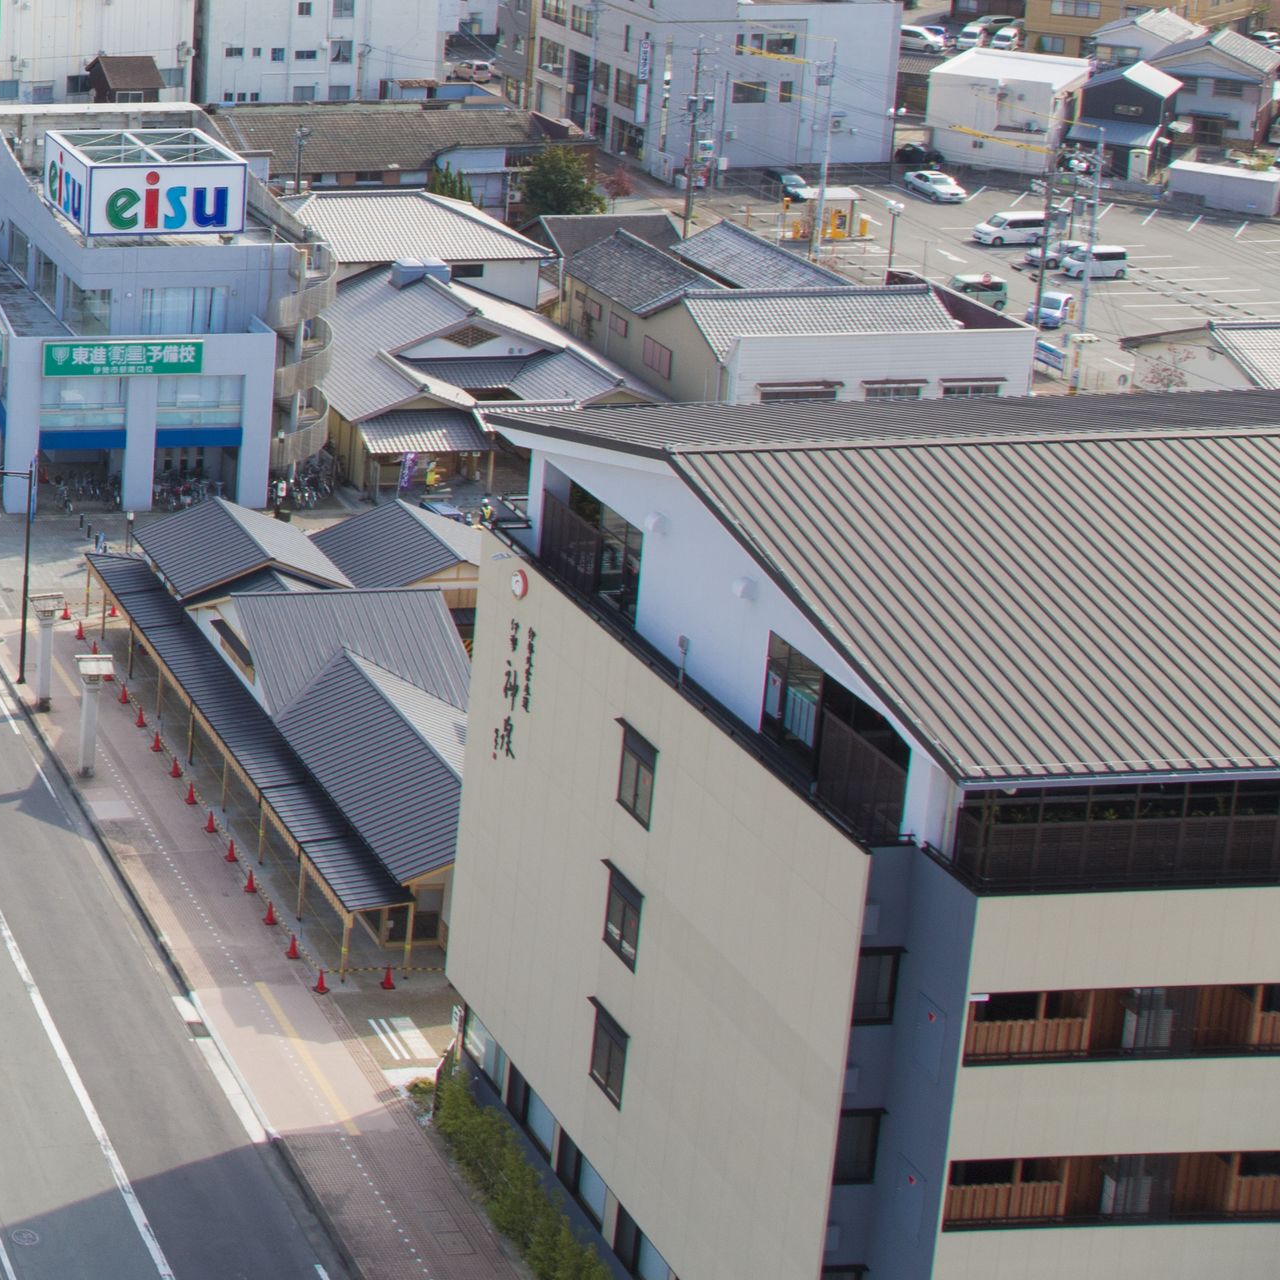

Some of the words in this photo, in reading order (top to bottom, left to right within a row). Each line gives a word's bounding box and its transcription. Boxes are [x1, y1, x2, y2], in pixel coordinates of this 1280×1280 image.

[48, 150, 83, 224] eisu
[106, 171, 228, 230] eisu
[72, 345, 196, 365] 東進衛星予備校
